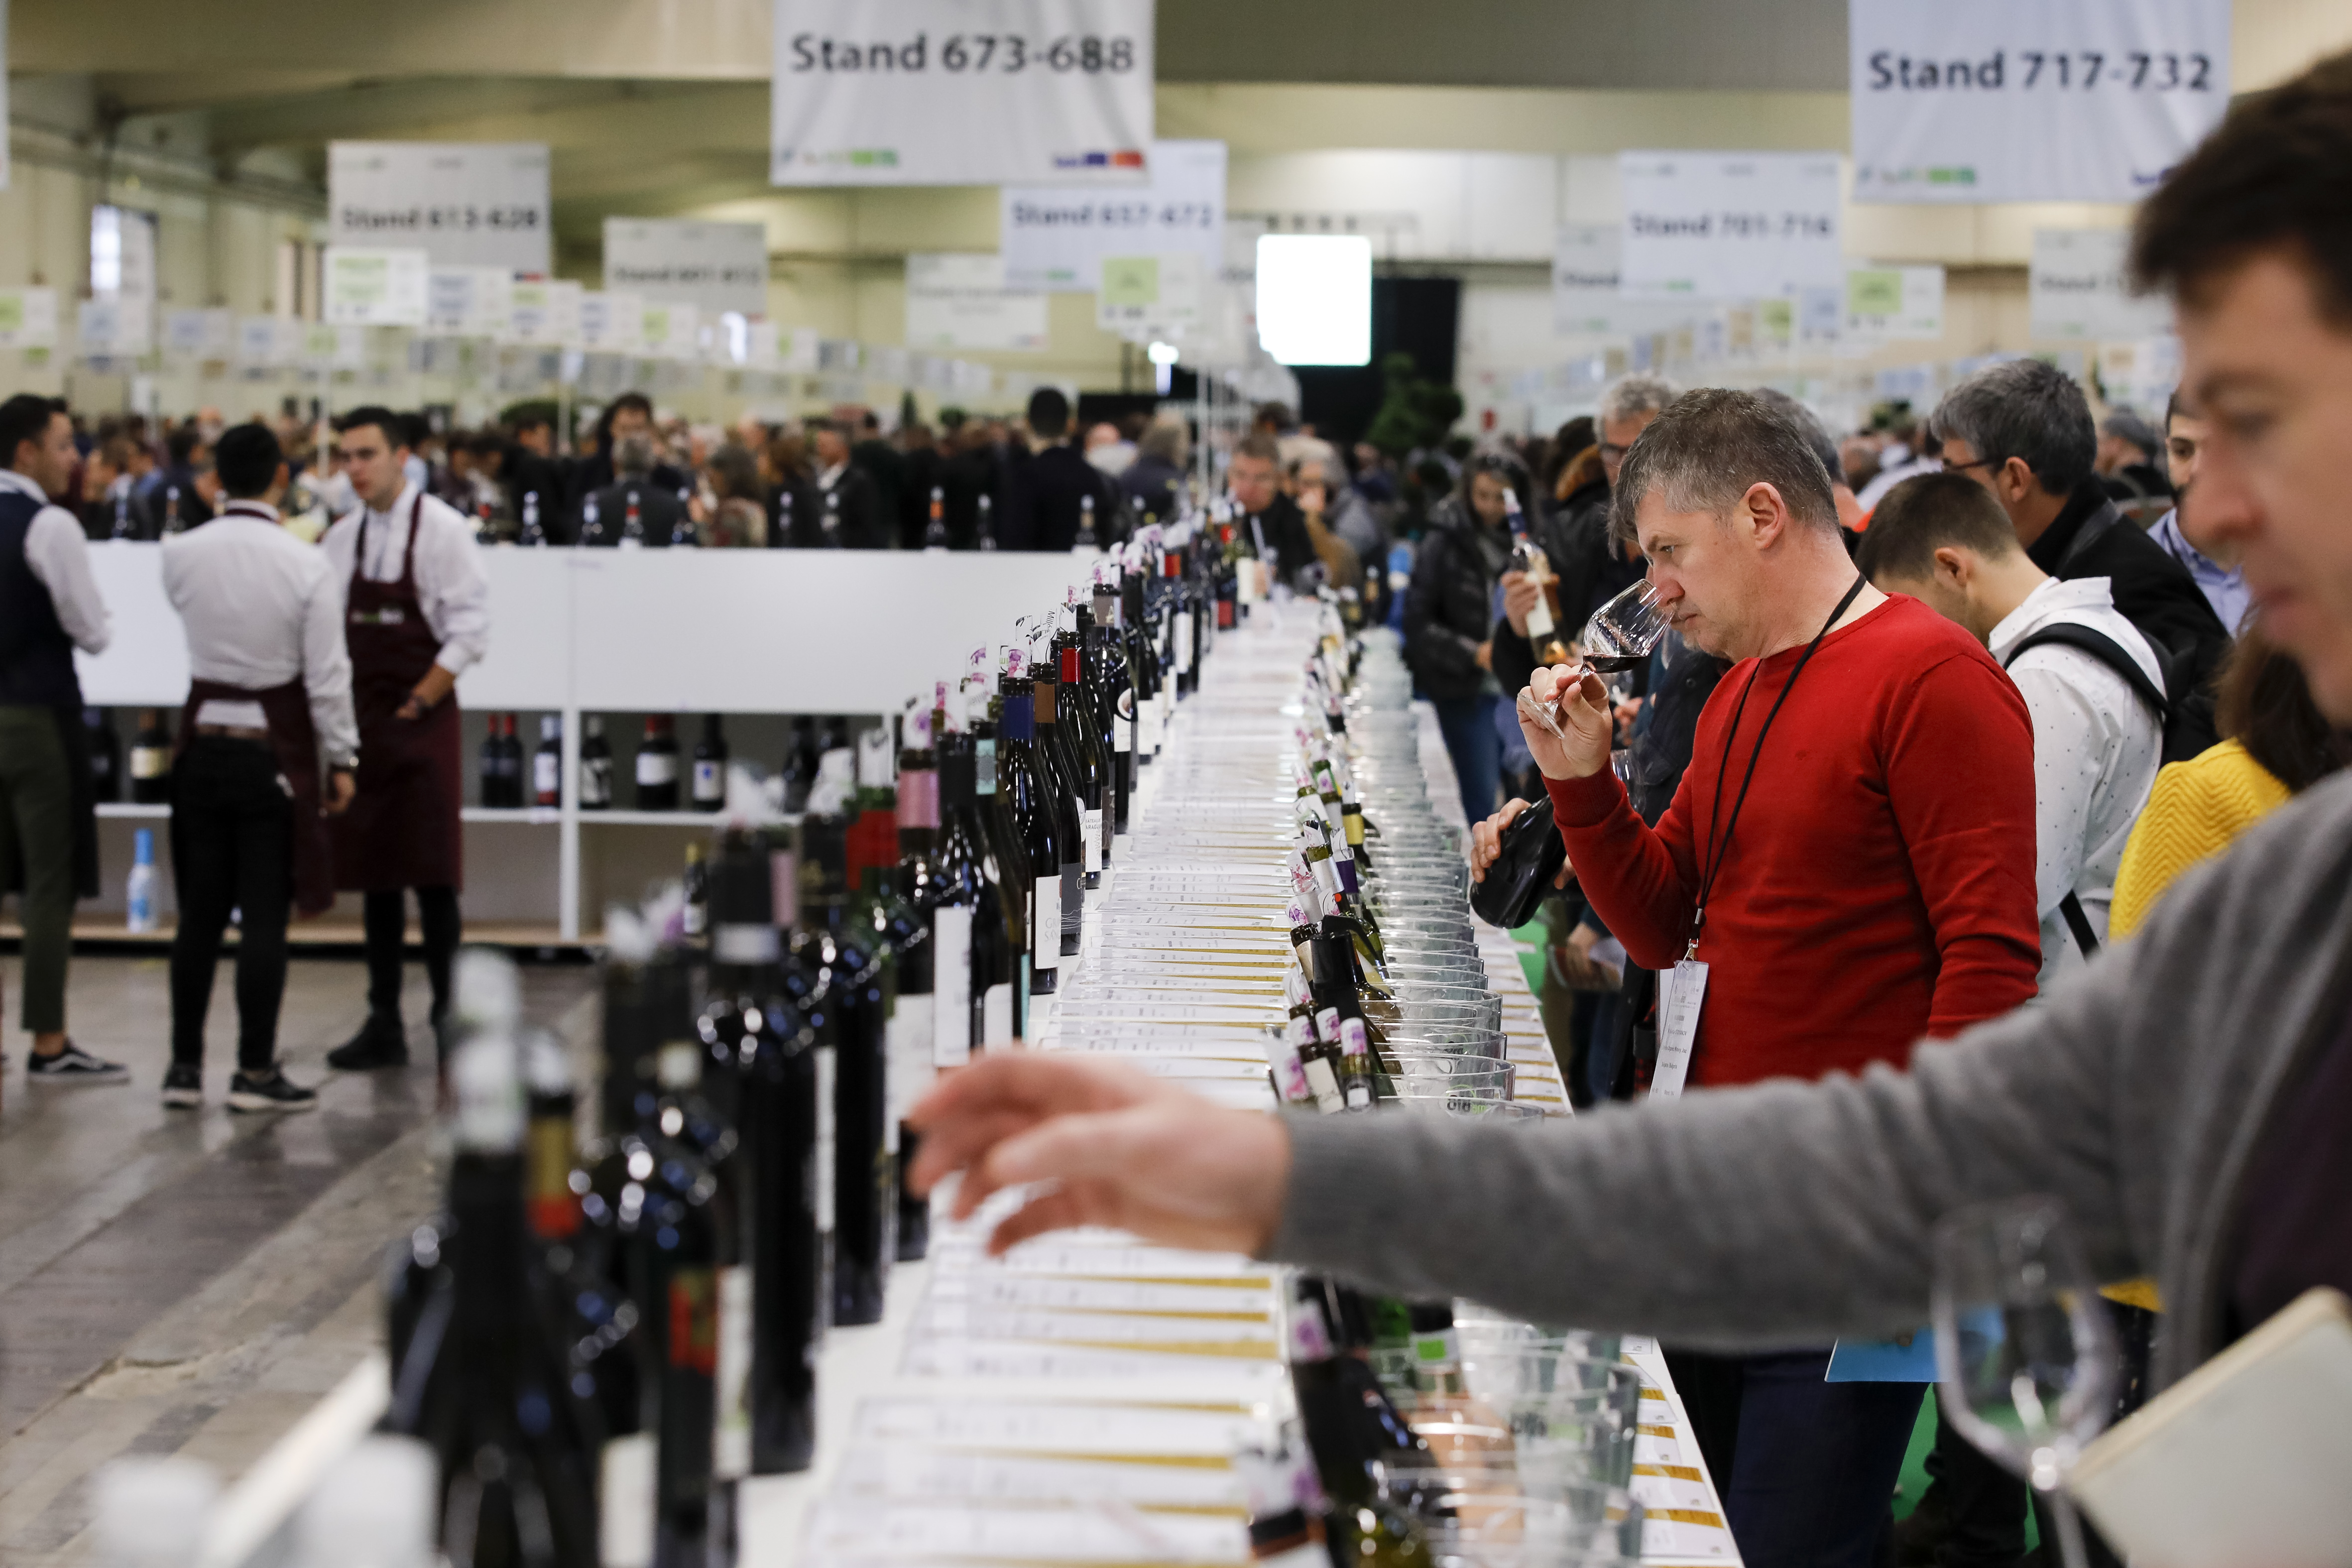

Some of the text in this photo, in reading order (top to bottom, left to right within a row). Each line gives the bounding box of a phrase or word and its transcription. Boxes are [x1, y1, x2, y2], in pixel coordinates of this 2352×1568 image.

[791, 32, 1135, 74] Stand 673-688
[1869, 51, 2212, 92] Stand 717-732
[344, 205, 421, 231] Stand
[1012, 203, 1093, 228] Stand
[1631, 213, 1711, 238] Stand
